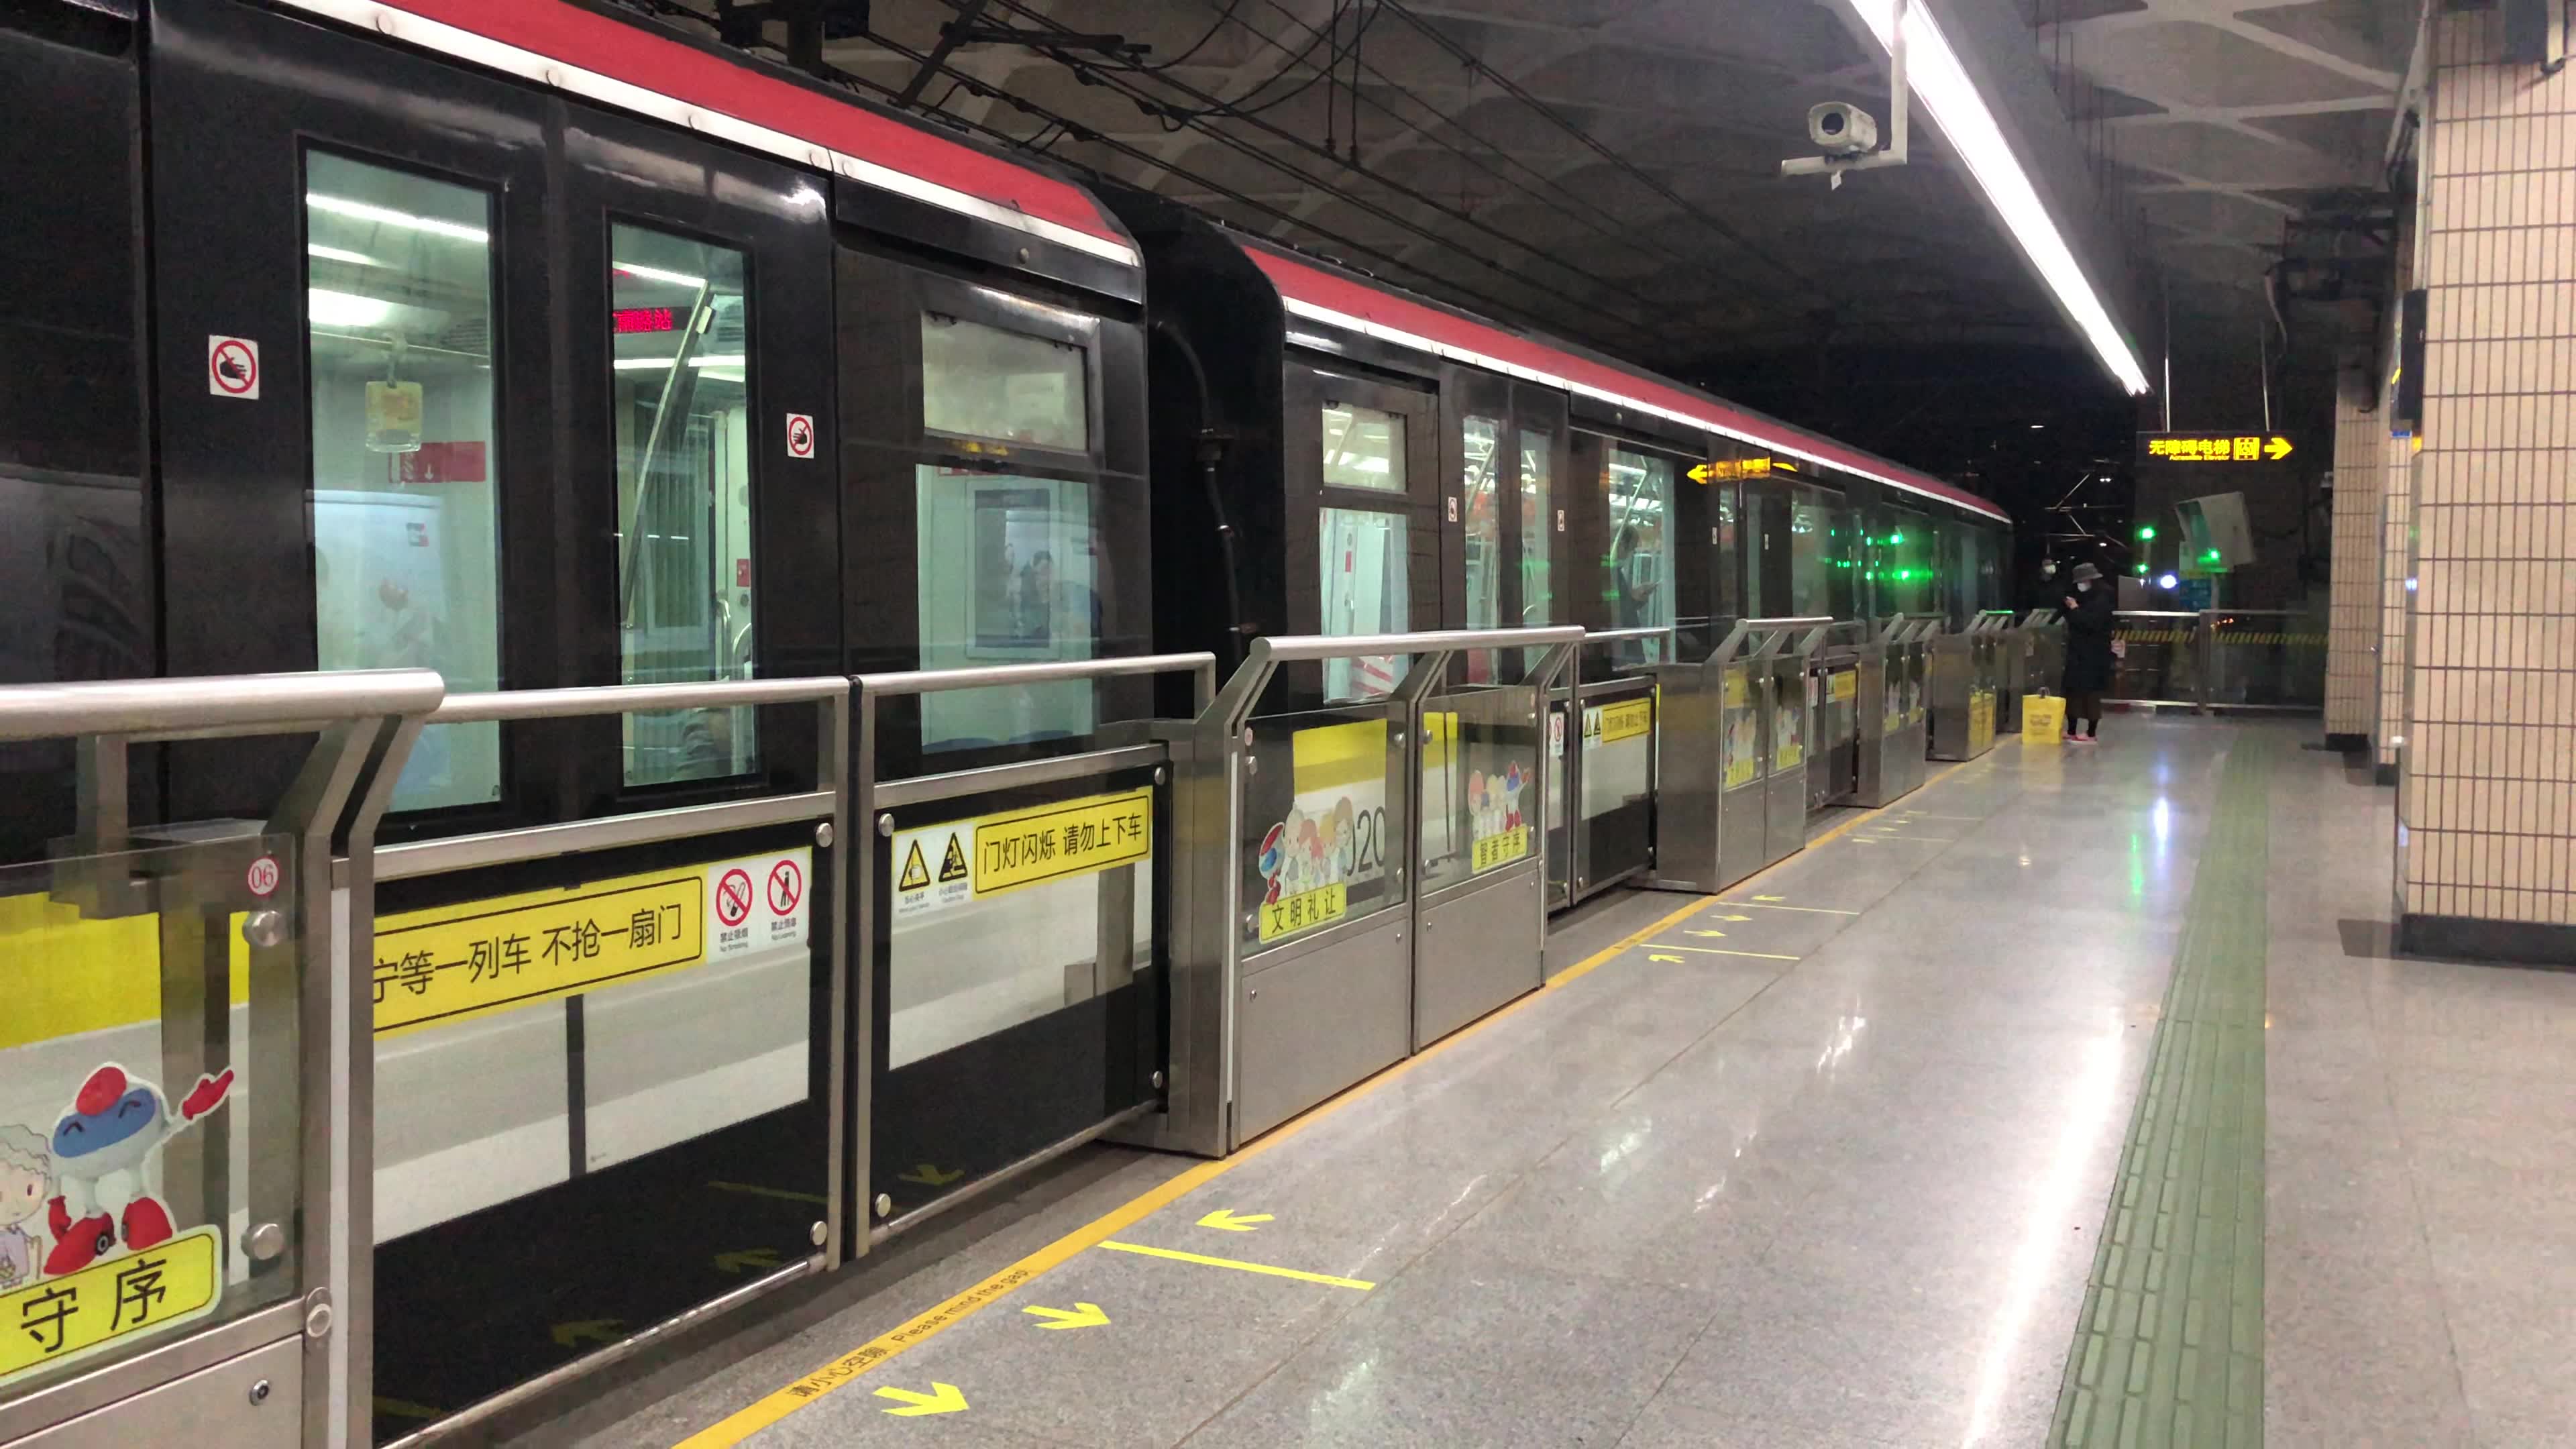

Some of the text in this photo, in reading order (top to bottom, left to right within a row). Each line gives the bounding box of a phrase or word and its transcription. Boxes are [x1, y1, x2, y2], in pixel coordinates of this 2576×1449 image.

[2149, 439, 2231, 455] 无障碍电梯
[983, 812, 1142, 875] 门灯闪烁 请勿上下车
[252, 863, 274, 889] 06
[541, 903, 682, 967] 不抢一扇门
[1272, 888, 1336, 934] 文明礼让
[21, 1258, 167, 1353] 守序
[890, 1269, 1029, 1342] Please mind the gap
[788, 1346, 890, 1397] 请小心空隙
